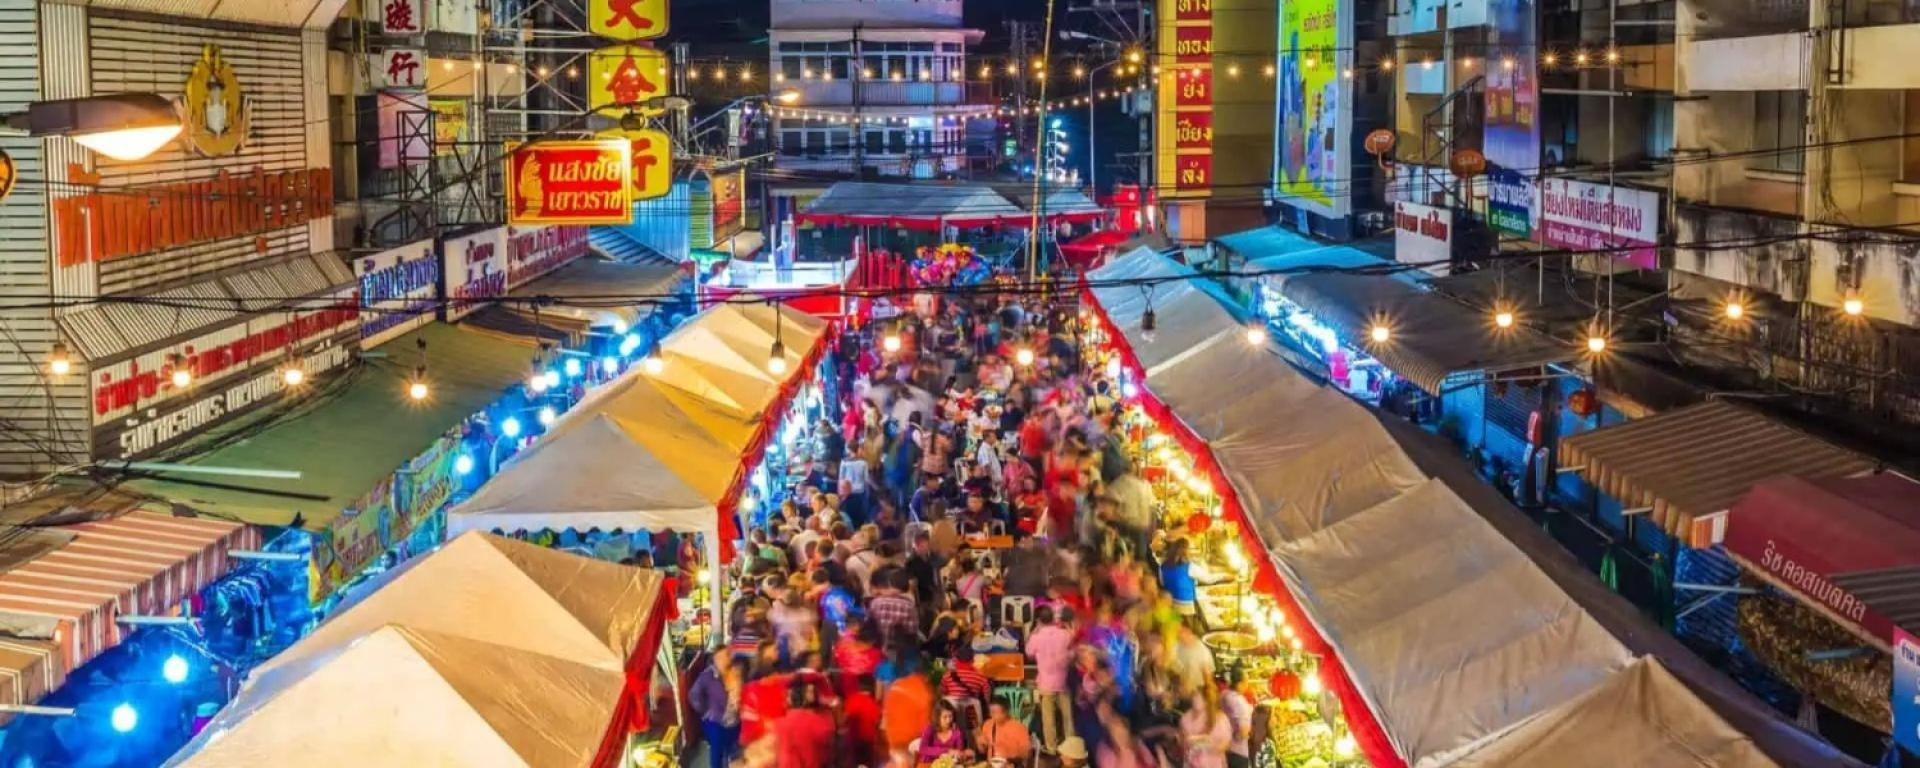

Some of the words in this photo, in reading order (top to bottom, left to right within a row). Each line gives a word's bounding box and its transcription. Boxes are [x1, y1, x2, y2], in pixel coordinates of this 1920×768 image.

[1178, 39, 1211, 55] ทอง
[548, 156, 622, 182] แสงชัย
[548, 190, 622, 211] เยาวราช
